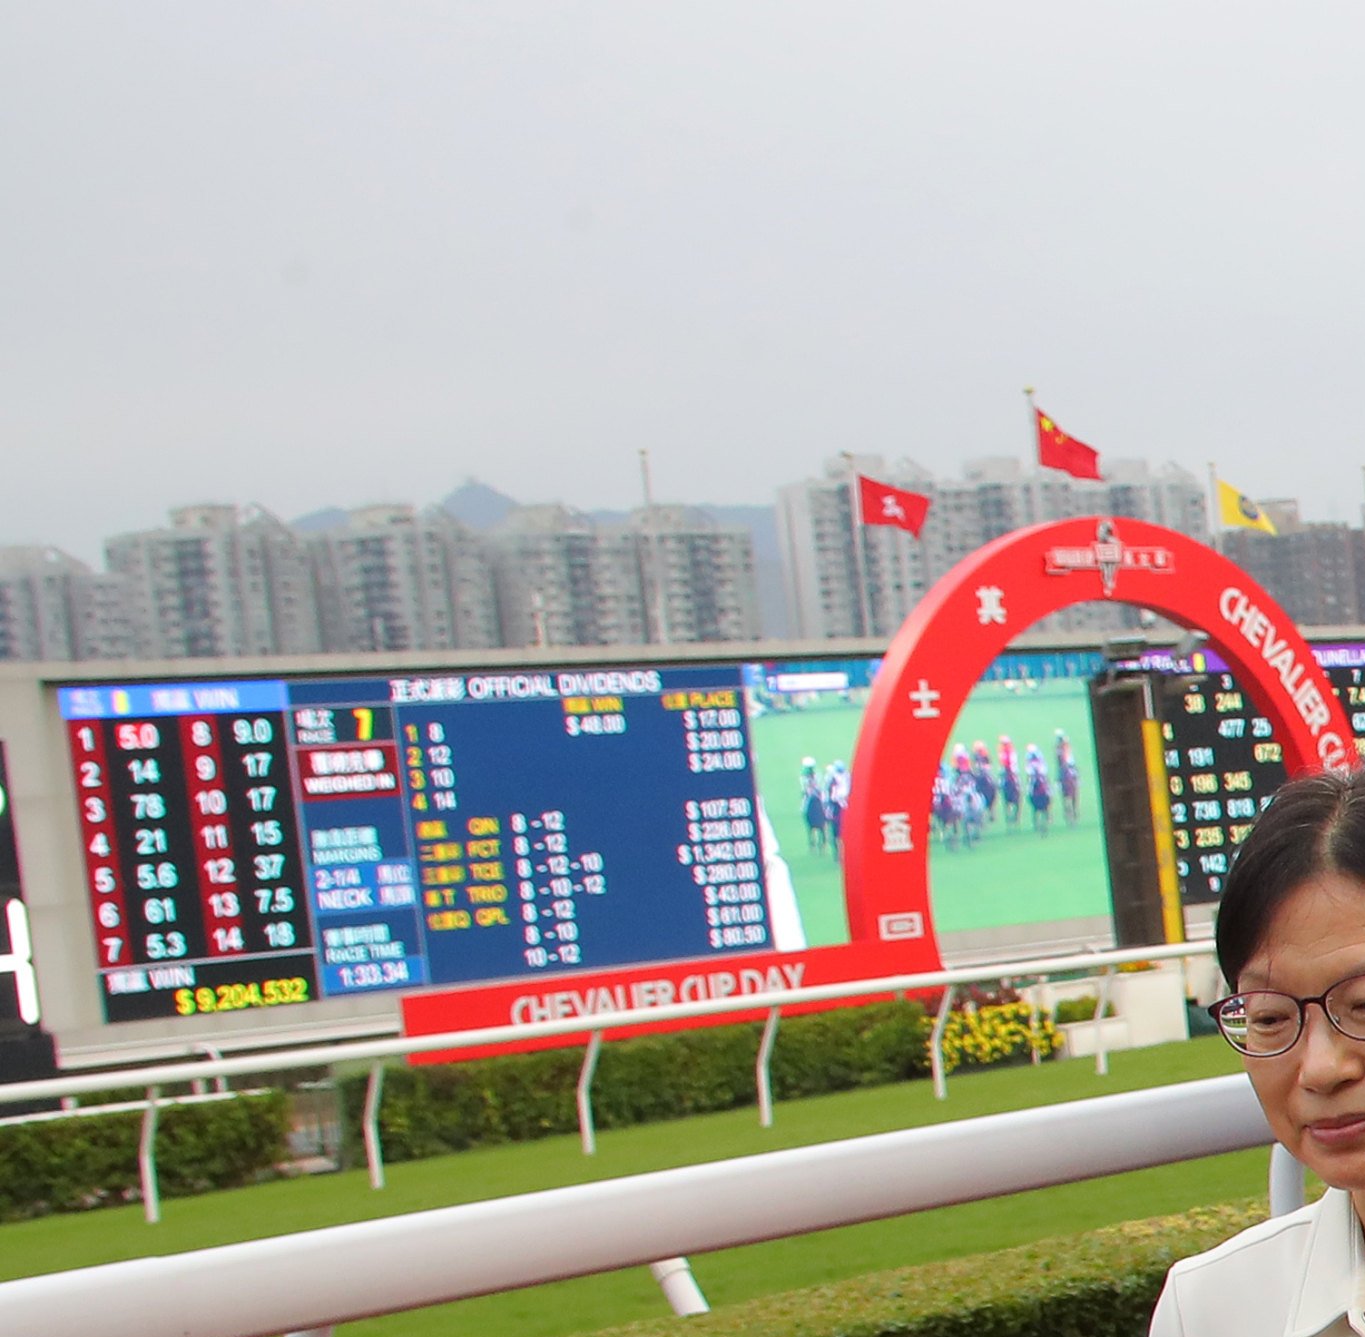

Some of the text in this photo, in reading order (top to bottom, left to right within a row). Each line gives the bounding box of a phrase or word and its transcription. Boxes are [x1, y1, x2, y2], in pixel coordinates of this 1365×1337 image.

[1219, 587, 1331, 736] CHEVALIER
[1313, 650, 1365, 666] UINELLA
[468, 675, 557, 698] OFFICIAL
[559, 671, 661, 695] DIVIDENDS
[691, 691, 736, 707] PLACE
[118, 724, 159, 748] 5.0
[192, 722, 211, 745] 8
[234, 719, 272, 743] 9.0
[353, 708, 373, 740] 7
[406, 723, 419, 743] 1
[79, 728, 93, 750] 1
[196, 755, 216, 780] 9
[243, 753, 272, 777] 17
[409, 748, 421, 766] 2
[429, 746, 451, 765] 12
[80, 762, 100, 787] 2
[128, 759, 160, 783] 14
[411, 769, 425, 789] 3
[432, 768, 455, 787] 10
[86, 797, 106, 822] 3
[196, 790, 226, 814] 10
[248, 787, 277, 811] 17
[414, 792, 427, 810] 4
[90, 833, 109, 855] 4
[137, 829, 167, 854] 21
[202, 826, 227, 848] 11
[252, 821, 281, 845] 15
[137, 863, 177, 888] 5.6
[205, 859, 235, 883] 12
[254, 855, 284, 879] 37
[96, 868, 115, 892] 5
[209, 893, 239, 917] 13
[255, 888, 293, 912] 7.5
[318, 888, 372, 909] NECK
[100, 904, 120, 927] 6
[145, 899, 176, 923] 61
[147, 933, 186, 957] 5.3
[214, 927, 244, 951] 14
[265, 923, 295, 946] 18
[104, 938, 122, 962] 7
[327, 942, 404, 963] RACE TIME
[151, 968, 194, 987] WIN
[510, 962, 806, 1026] CHEVALIER CUP DAY
